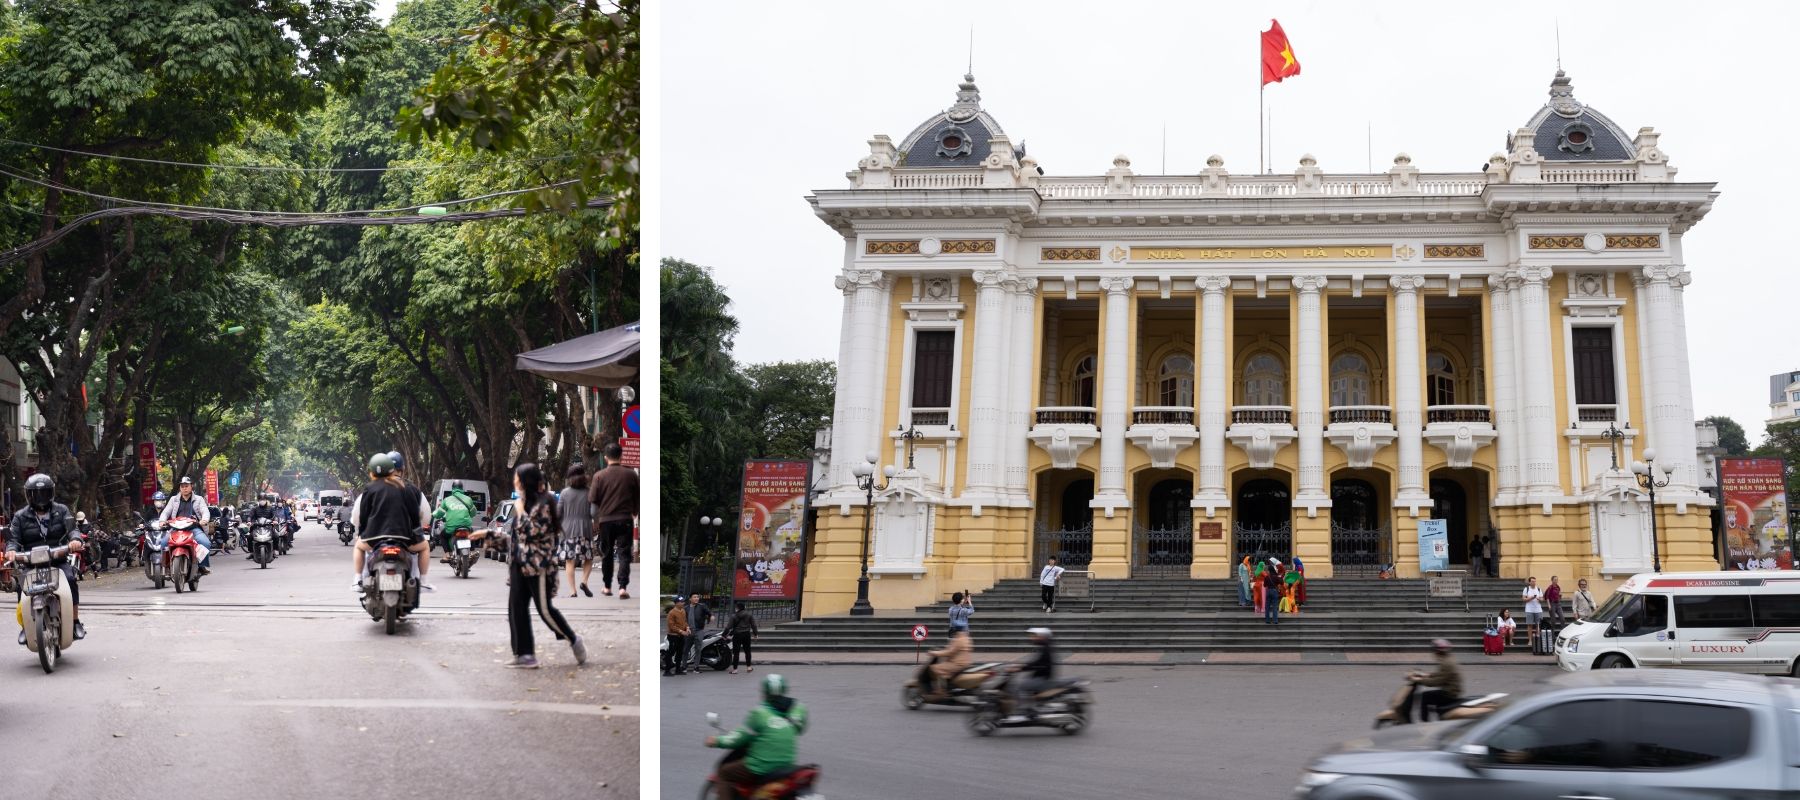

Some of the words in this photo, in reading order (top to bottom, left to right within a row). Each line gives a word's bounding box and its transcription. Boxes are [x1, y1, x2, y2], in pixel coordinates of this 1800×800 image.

[1147, 248, 1186, 260] NHÀ
[1200, 247, 1236, 259] HÁT
[1303, 246, 1328, 258] HÀ
[1691, 645, 1747, 653] LUXURY
